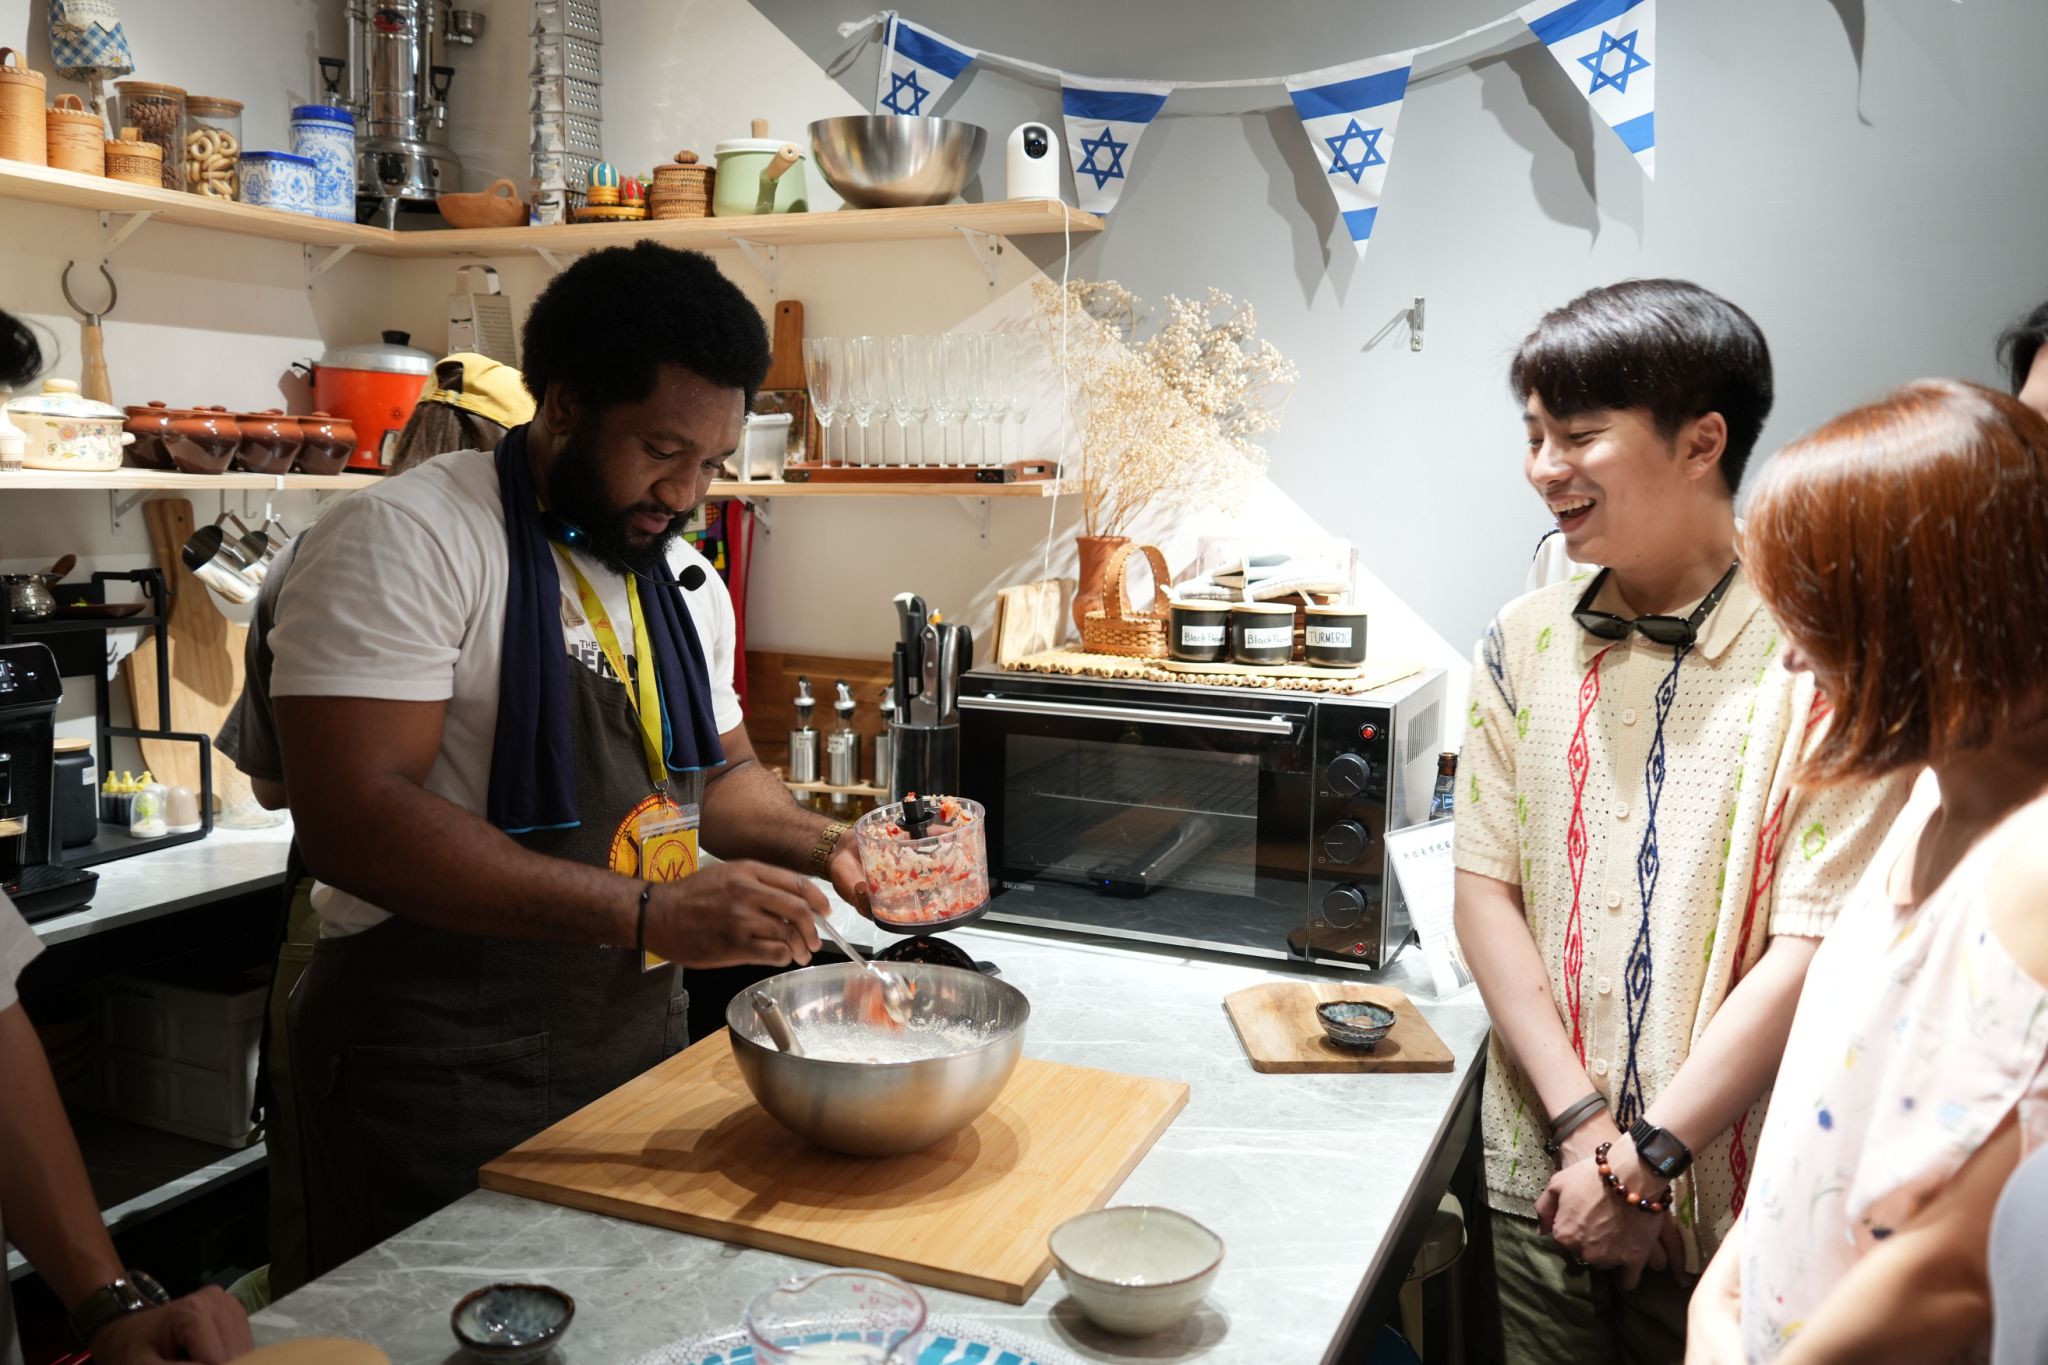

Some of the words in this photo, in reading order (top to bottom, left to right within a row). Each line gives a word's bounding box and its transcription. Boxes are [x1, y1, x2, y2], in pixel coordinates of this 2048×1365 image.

[1184, 632, 1206, 642] Black
[1247, 633, 1272, 645] Black
[1307, 630, 1351, 645] TURMERIC
[579, 639, 598, 651] THE
